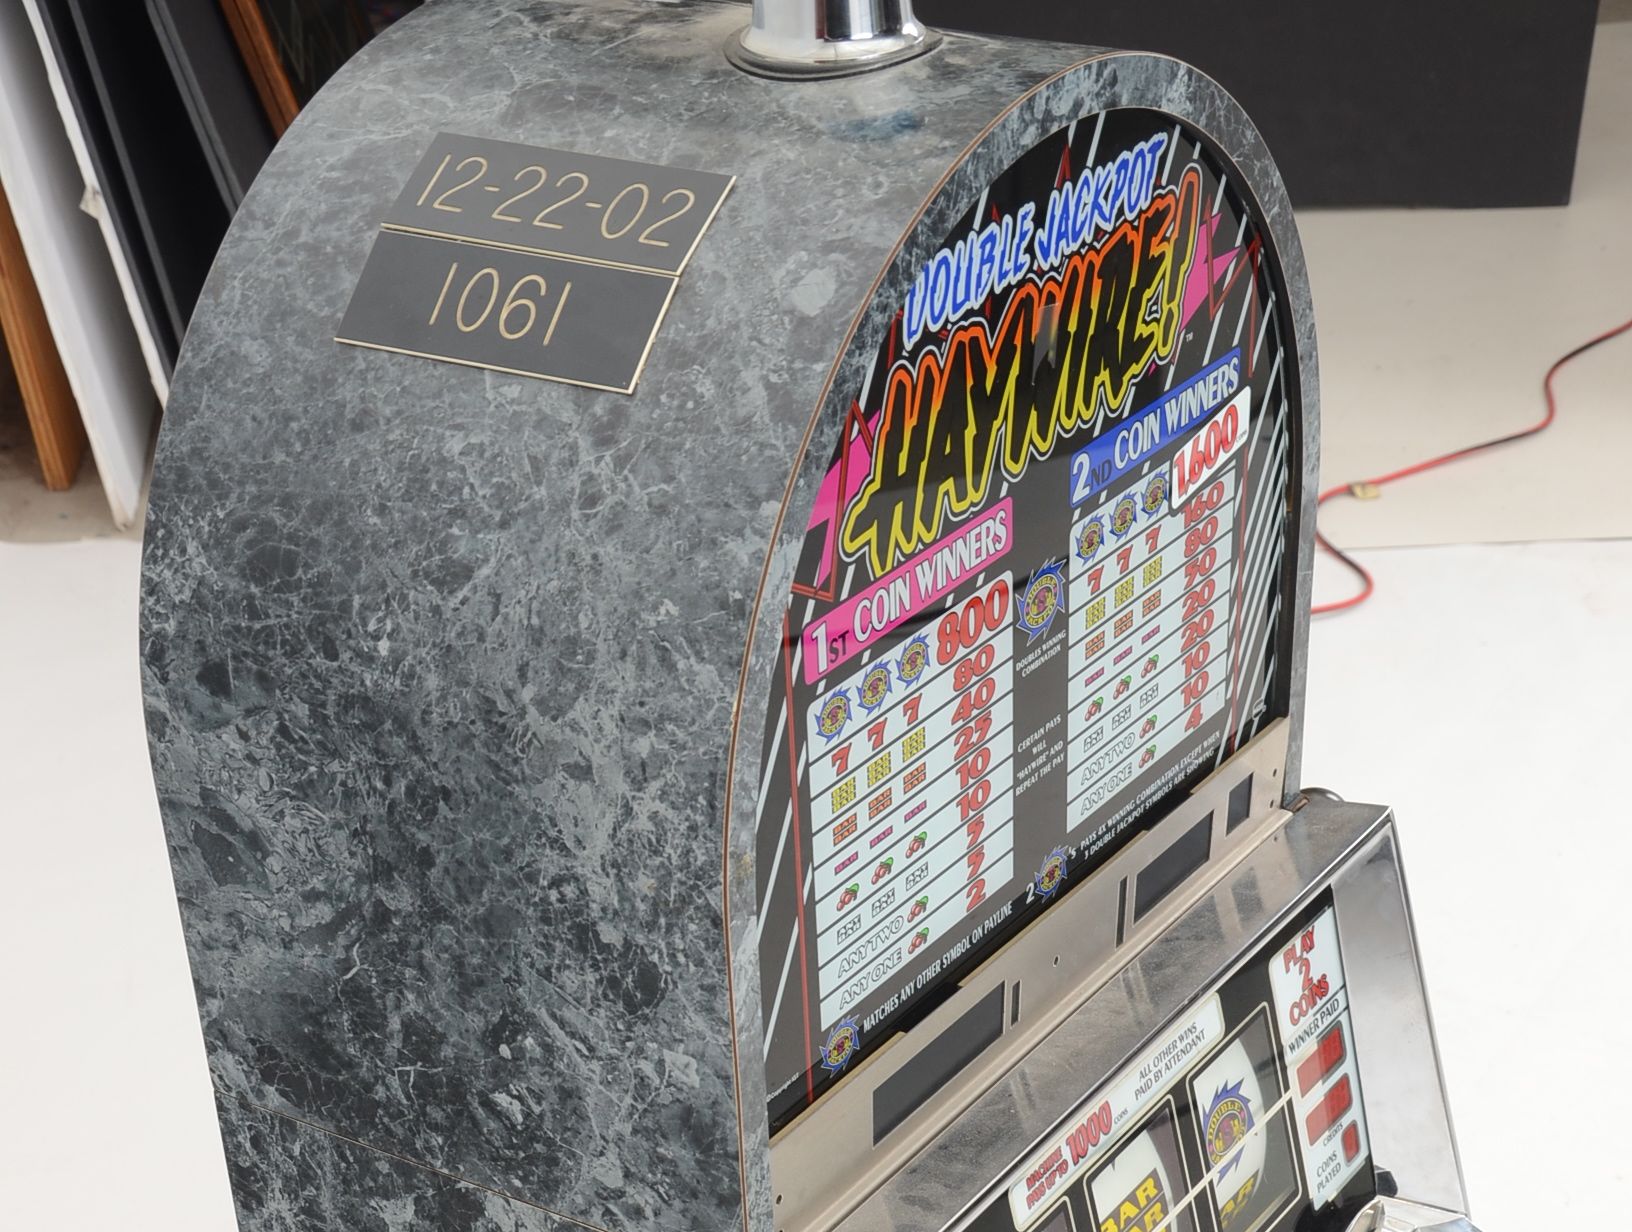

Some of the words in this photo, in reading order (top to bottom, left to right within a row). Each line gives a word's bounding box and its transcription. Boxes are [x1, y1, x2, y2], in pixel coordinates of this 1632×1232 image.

[417, 154, 695, 247] 12-22-02
[903, 201, 1035, 351] DOUBLE
[1035, 132, 1168, 271] JACKPOT
[429, 262, 571, 346] 1061
[1114, 416, 1161, 470] COIN
[1164, 361, 1239, 434] WINNERS
[1183, 480, 1224, 529] 160
[854, 573, 911, 643] COIN
[915, 510, 1007, 599] WINNERS
[1088, 565, 1104, 596] 7
[1117, 544, 1133, 575] 7
[1145, 524, 1161, 553] 7
[1184, 516, 1218, 559] 80
[936, 578, 1009, 666] 800
[1182, 578, 1215, 622] 20
[1181, 609, 1215, 652] 20
[1015, 647, 1041, 671] DOUBLES
[1021, 644, 1061, 677] COMBINATION
[1181, 641, 1211, 679] 10
[832, 742, 852, 777] 7
[868, 717, 887, 751] 7
[903, 693, 922, 726] 7
[953, 643, 995, 692] 80
[951, 677, 995, 725] 40
[1181, 671, 1209, 708] 10
[954, 710, 992, 762] 25
[1050, 740, 1064, 756] AND
[1081, 754, 1107, 785] ANY
[1106, 732, 1135, 764] TWO
[1185, 703, 1203, 733] 4
[955, 747, 991, 790] 10
[1015, 772, 1039, 796] REPEAT
[1039, 762, 1051, 777] THE
[1052, 752, 1065, 768] PAY
[1081, 783, 1107, 816] ANY
[1106, 762, 1133, 793] ONE
[956, 779, 991, 822] 10
[1025, 882, 1034, 904] 2
[1080, 831, 1097, 851] PAYS
[1108, 799, 1136, 828] WINNING
[1136, 763, 1179, 804] COMBINATION
[1180, 744, 1203, 770] EXCEPT
[1203, 731, 1220, 750] WHEN
[1090, 829, 1115, 855] DOUBLE
[1117, 805, 1145, 834] JACKPOT
[1145, 780, 1173, 809] SYMBOLS
[1174, 771, 1186, 785] ARE
[1187, 749, 1215, 776] SHOWING
[967, 813, 984, 850] 5
[838, 941, 870, 978] ANY
[869, 915, 904, 951] TWO
[967, 844, 984, 881] 5
[840, 971, 871, 1010] ANY
[871, 947, 902, 982] ONE
[966, 878, 986, 913] 2
[863, 994, 900, 1033] MATCHES
[900, 981, 919, 1004] ANY
[917, 961, 942, 989] OTHER
[942, 938, 971, 969] SYMBOL
[972, 923, 984, 944] ON
[984, 900, 1013, 934] PAYLINE
[1283, 924, 1315, 974] PLAY
[1290, 973, 1329, 1026] COINS
[1298, 957, 1313, 992] 2
[1139, 1067, 1152, 1082] ALL
[1152, 1042, 1179, 1069] OTHER
[1178, 1022, 1198, 1047] WINS
[1288, 1022, 1320, 1055] WINNER
[1320, 998, 1340, 1024] PAID
[1134, 1077, 1153, 1100] PAID
[1154, 1067, 1165, 1084] BY
[1164, 1029, 1206, 1075] ATTENDANT
[1065, 1100, 1112, 1166] 1000
[1208, 1101, 1241, 1140] DOUBLE
[1323, 1122, 1343, 1147] CREDITS
[1317, 1150, 1337, 1177] COINS
[1317, 1162, 1341, 1193] PLAYED
